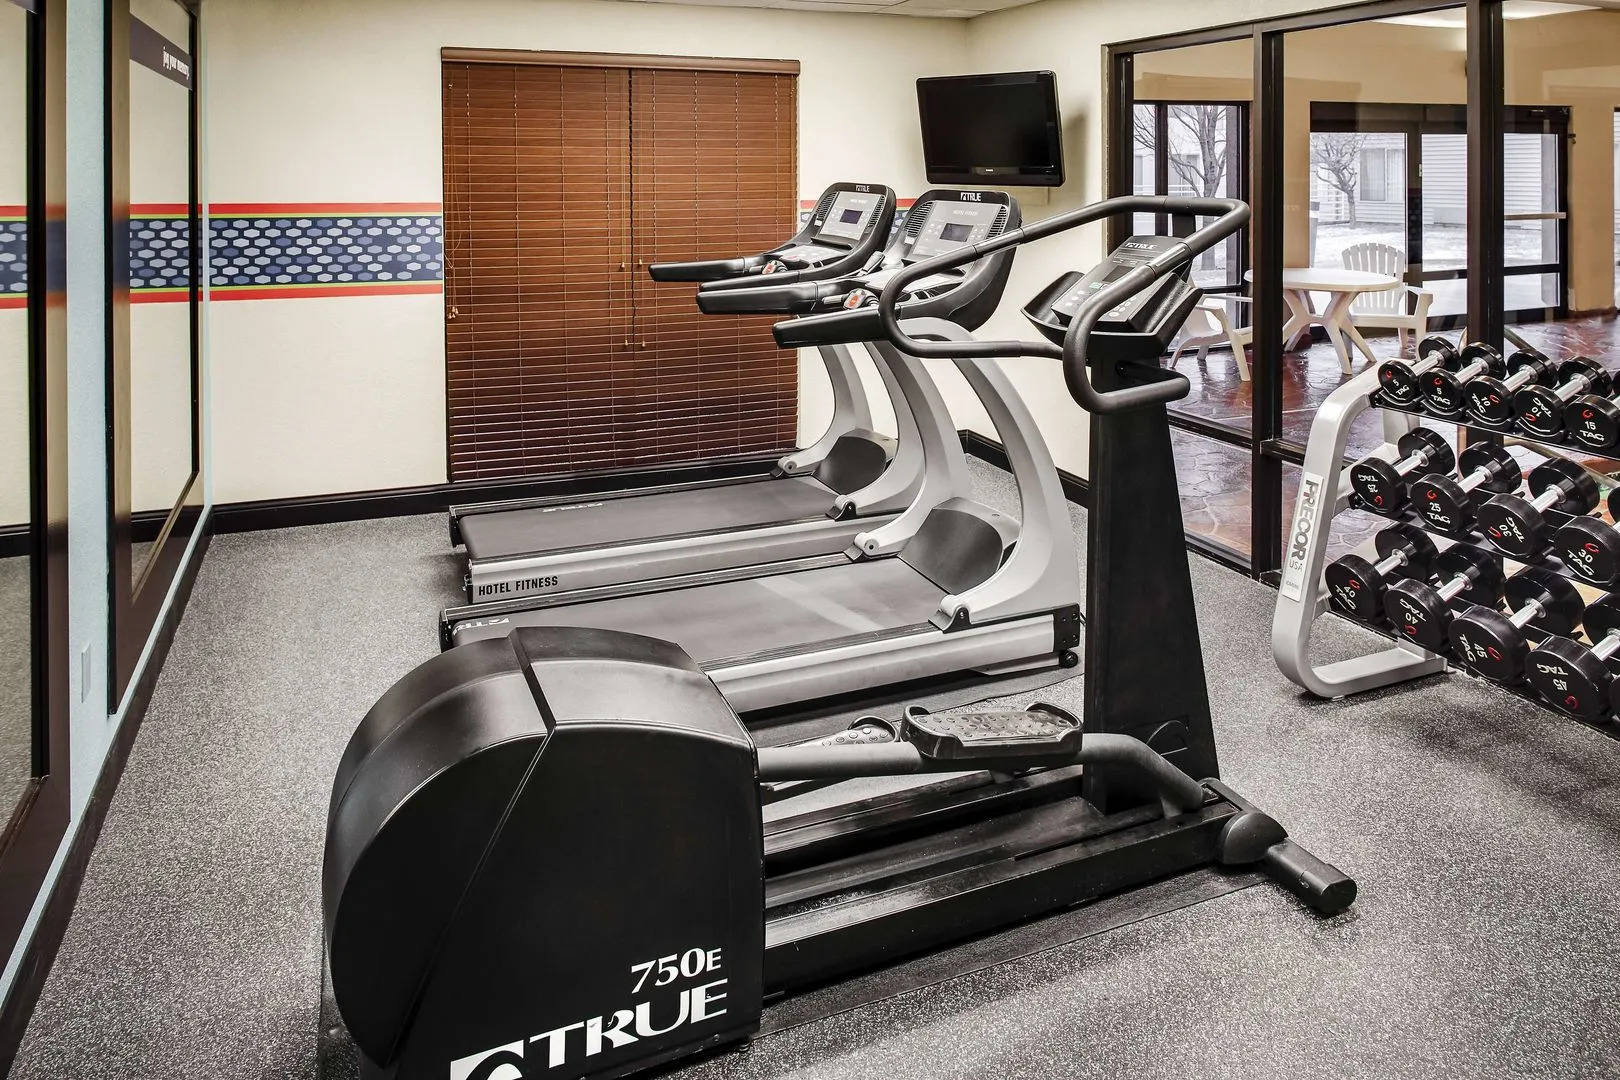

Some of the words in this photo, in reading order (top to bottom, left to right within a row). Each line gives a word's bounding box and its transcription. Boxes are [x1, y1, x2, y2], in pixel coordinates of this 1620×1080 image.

[1480, 396, 1491, 406] 10
[1531, 406, 1543, 417] 10
[1584, 421, 1597, 430] 15
[1429, 502, 1442, 512] 25
[1291, 479, 1319, 561] PRECOR
[1499, 524, 1512, 537] 30
[1578, 548, 1594, 563] 30
[1289, 559, 1303, 572] USA
[478, 583, 512, 596] HOTEL
[515, 575, 559, 592] FITNESS
[1343, 586, 1356, 598] 40
[1405, 612, 1419, 625] 40
[1459, 633, 1477, 663] TAG
[1473, 642, 1488, 659] 45
[1536, 663, 1569, 676] TAG
[1552, 678, 1568, 692] 45
[529, 978, 728, 1069] TRUE
